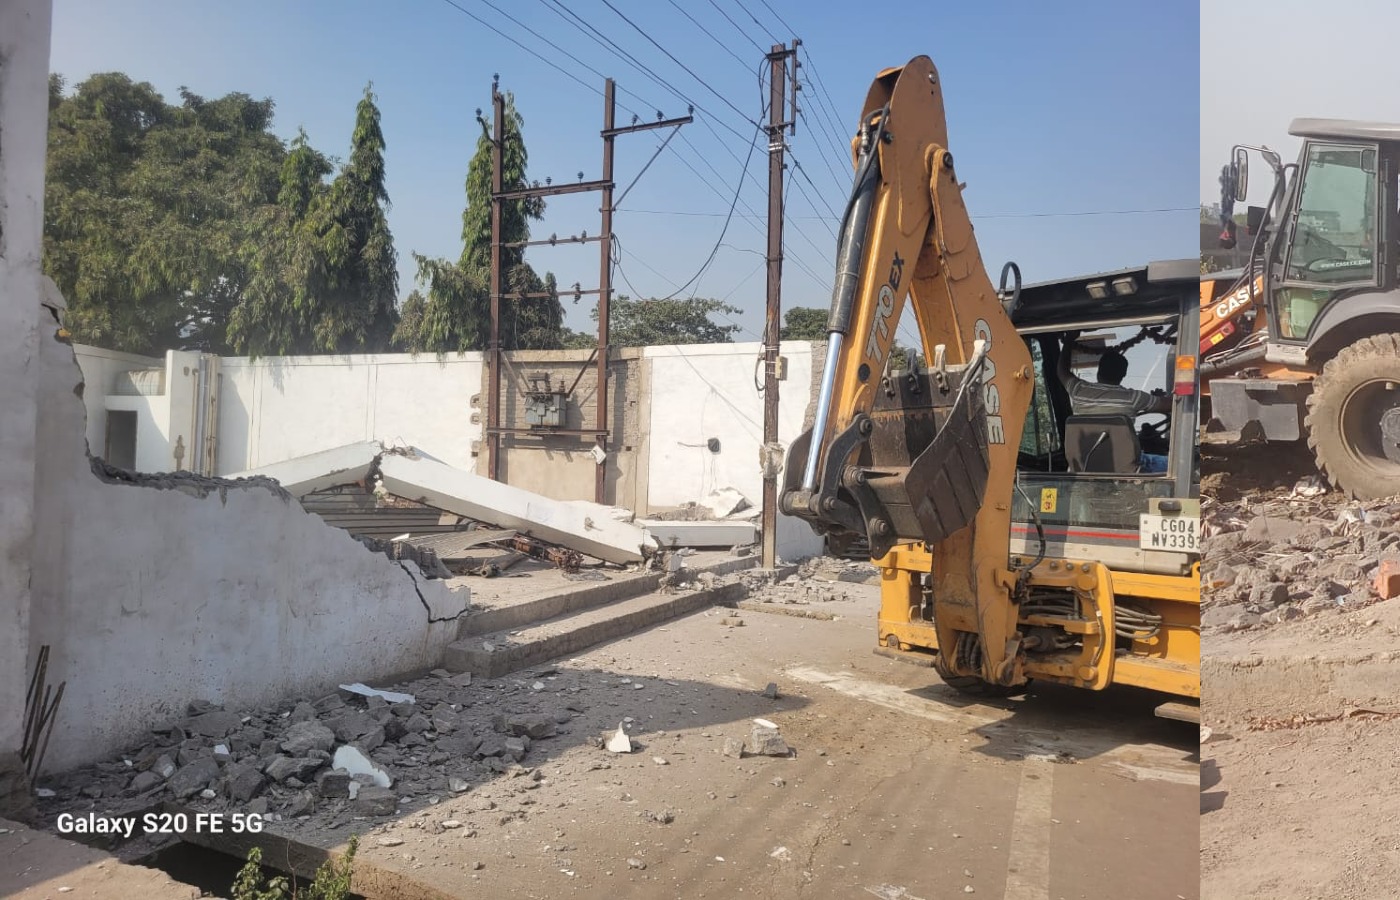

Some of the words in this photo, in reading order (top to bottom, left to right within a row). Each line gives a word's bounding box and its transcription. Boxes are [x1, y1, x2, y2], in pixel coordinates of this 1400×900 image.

[866, 284, 895, 364] 770
[889, 250, 905, 292] EX
[1216, 281, 1260, 318] CASE
[974, 318, 1005, 444] CASE
[1161, 518, 1195, 533] CG04
